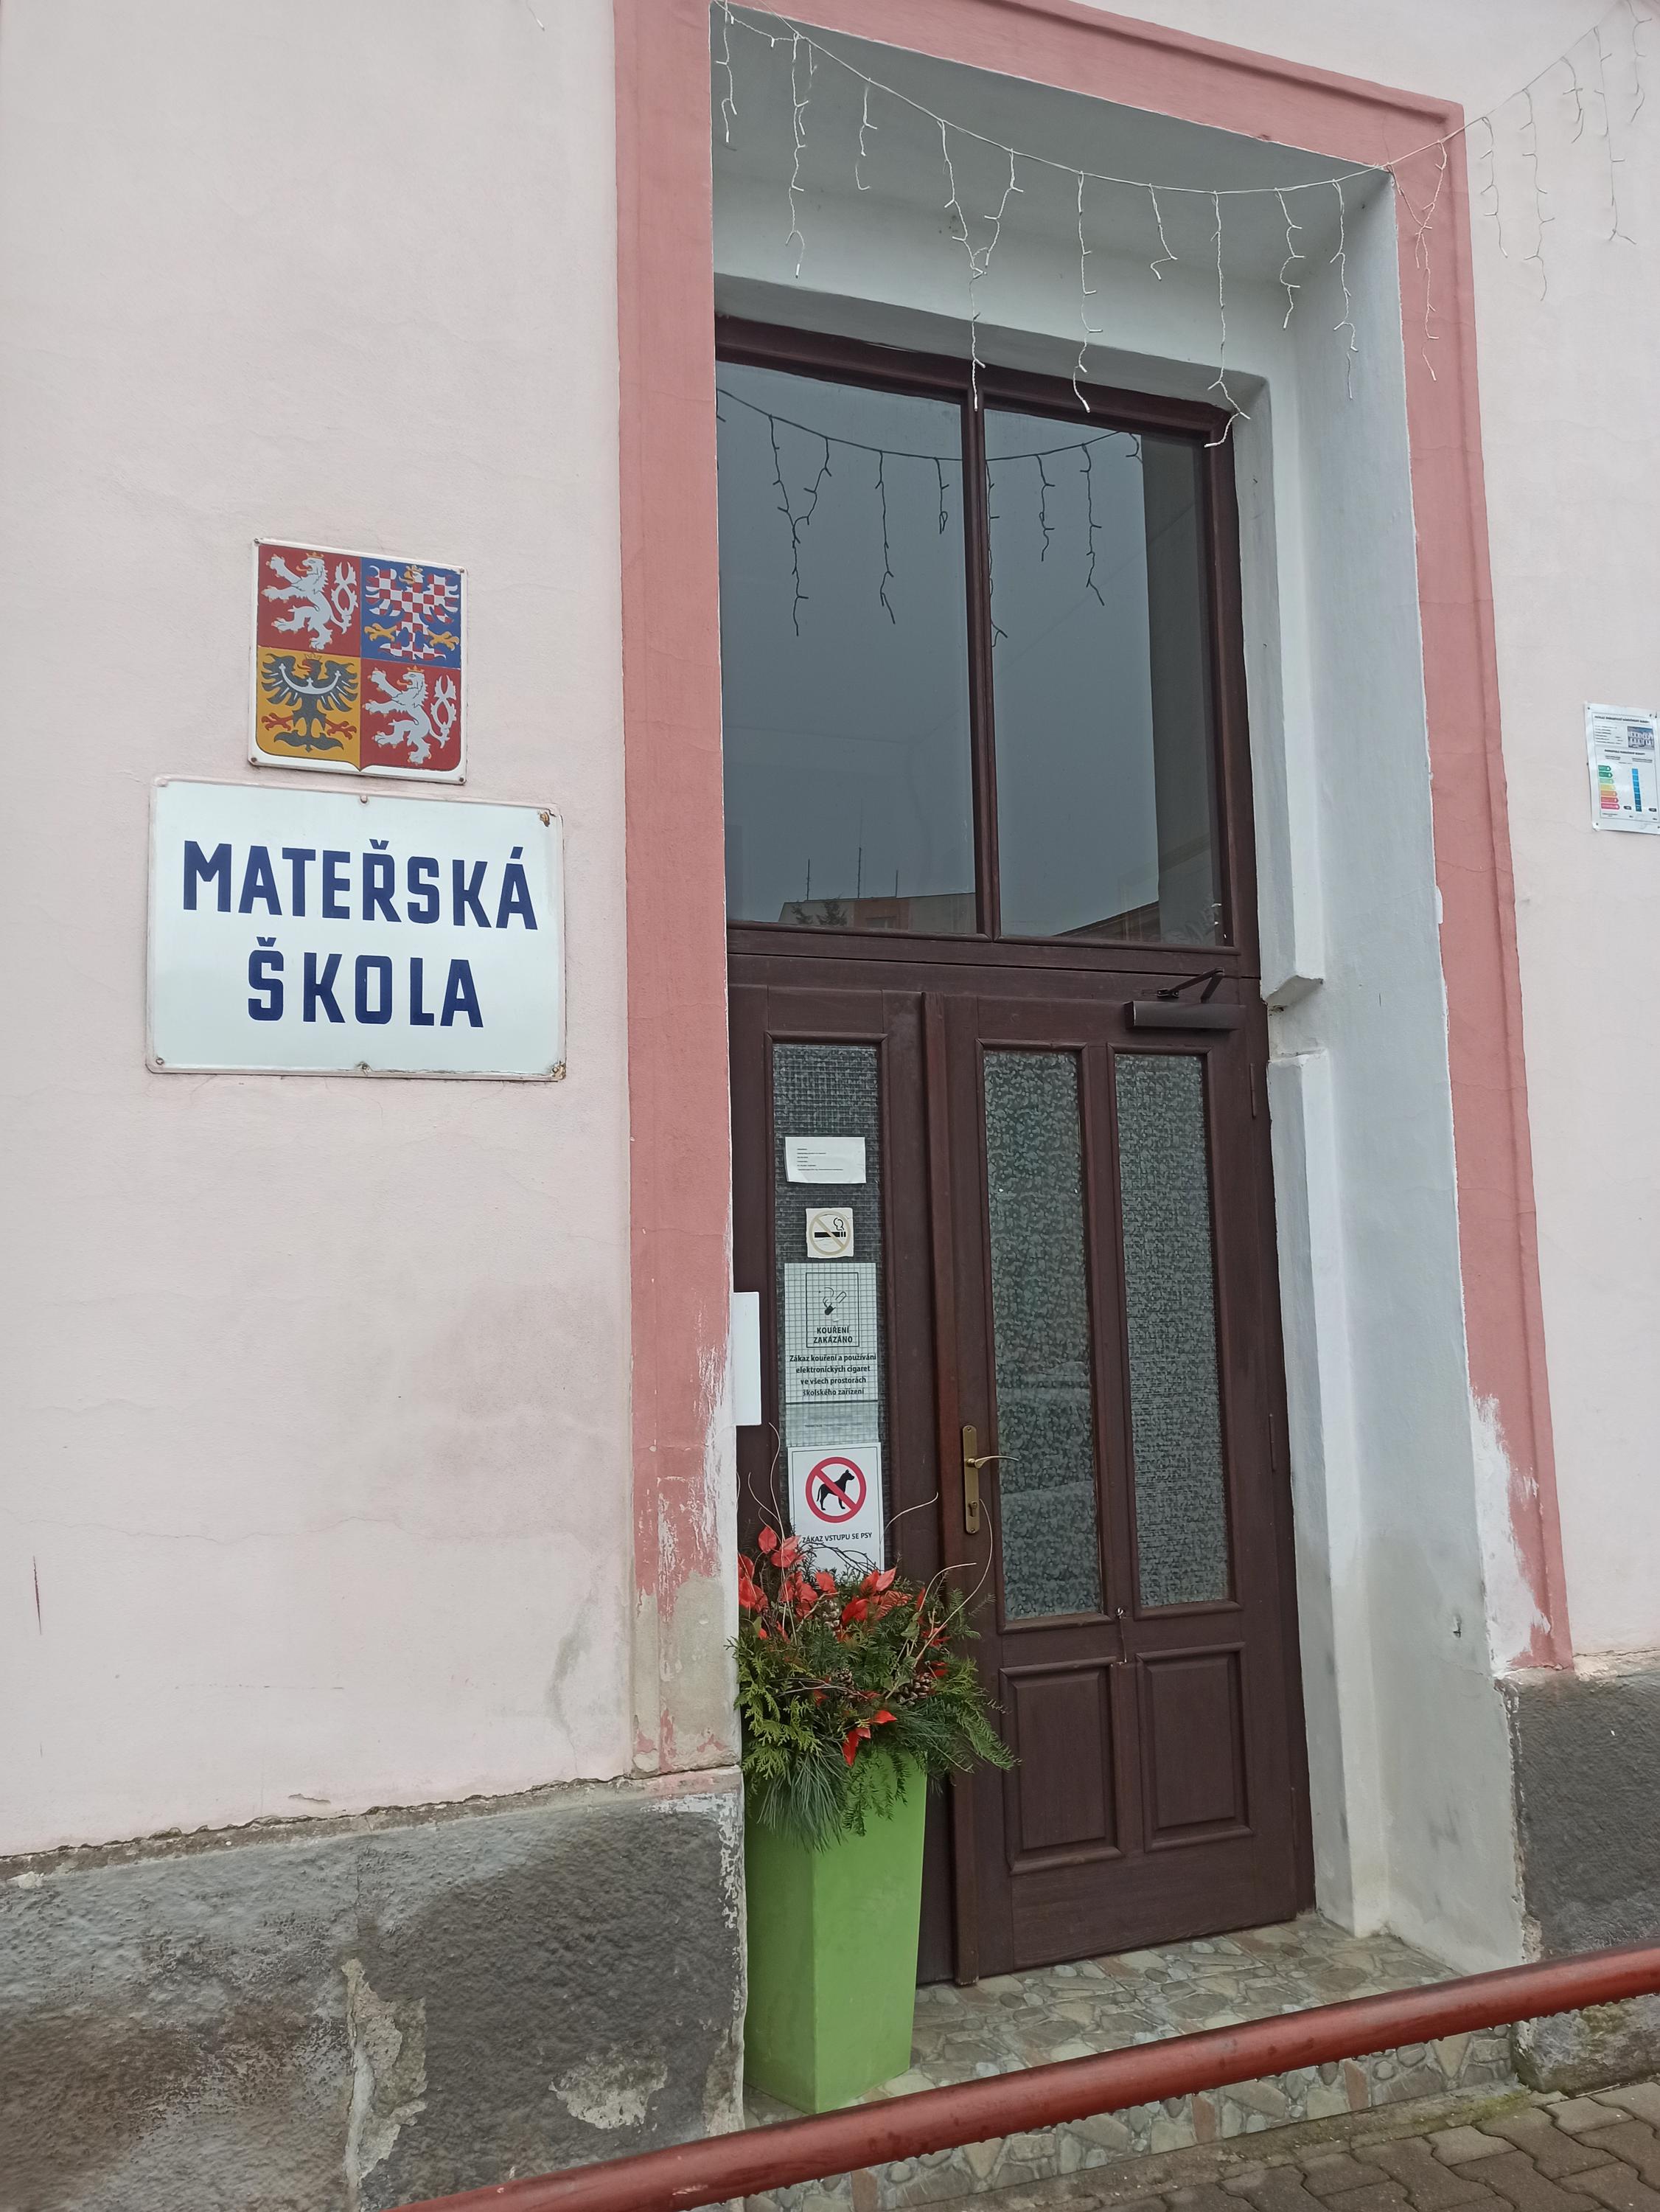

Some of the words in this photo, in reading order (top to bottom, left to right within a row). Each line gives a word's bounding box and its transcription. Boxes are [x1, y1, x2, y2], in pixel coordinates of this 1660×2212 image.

[184, 839, 538, 930] MATEŘSKÁ
[248, 936, 484, 1028] ŠKOLA
[817, 1326, 849, 1334] KOUŘENÍ
[813, 1335, 853, 1343] ZAKÁZÁNO
[789, 1354, 809, 1363] Zákaz
[811, 1354, 837, 1362] kouření
[843, 1353, 876, 1363] používání
[796, 1366, 845, 1374] elektronických
[847, 1366, 871, 1374] cigaret
[810, 1377, 829, 1385] všech
[830, 1376, 866, 1385] prostorách
[803, 1388, 837, 1397] školského
[802, 1535, 823, 1543] ZÁKAZ
